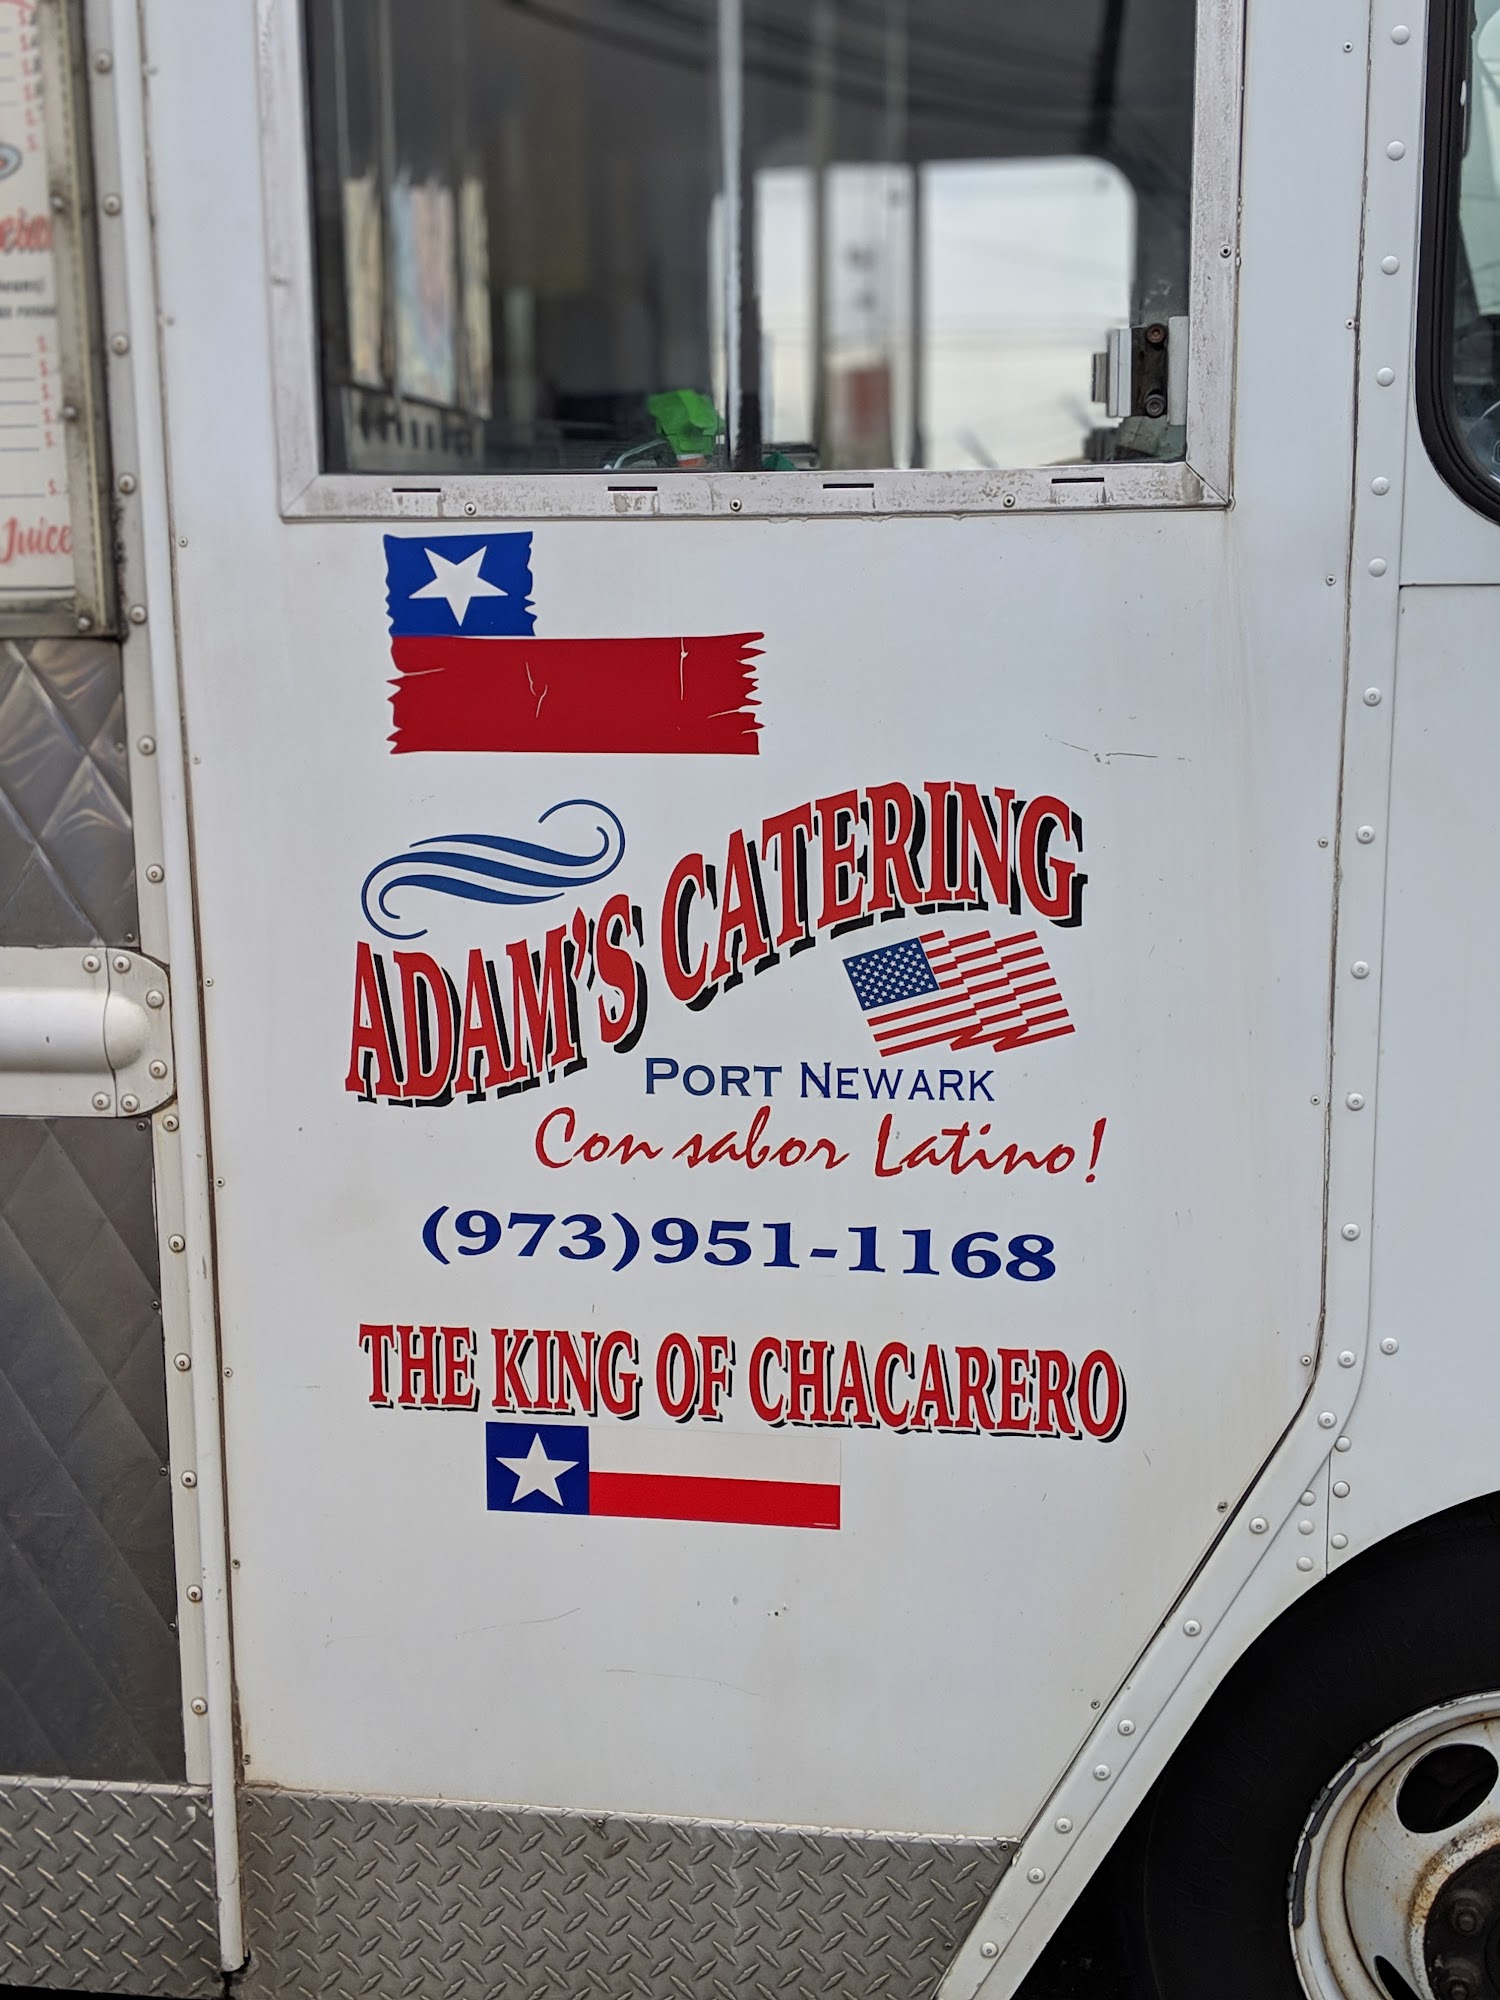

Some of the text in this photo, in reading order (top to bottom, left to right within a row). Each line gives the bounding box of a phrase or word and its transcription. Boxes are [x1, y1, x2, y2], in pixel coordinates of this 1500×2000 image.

[345, 781, 1088, 1108] ADAM'S CATERING
[646, 1058, 994, 1102] PORT NEWARK
[536, 1106, 1106, 1183] Con sabor Latino!
[423, 1206, 1056, 1282] (973)951-1168
[359, 1324, 1127, 1444] THE KING OF CHACARERO
